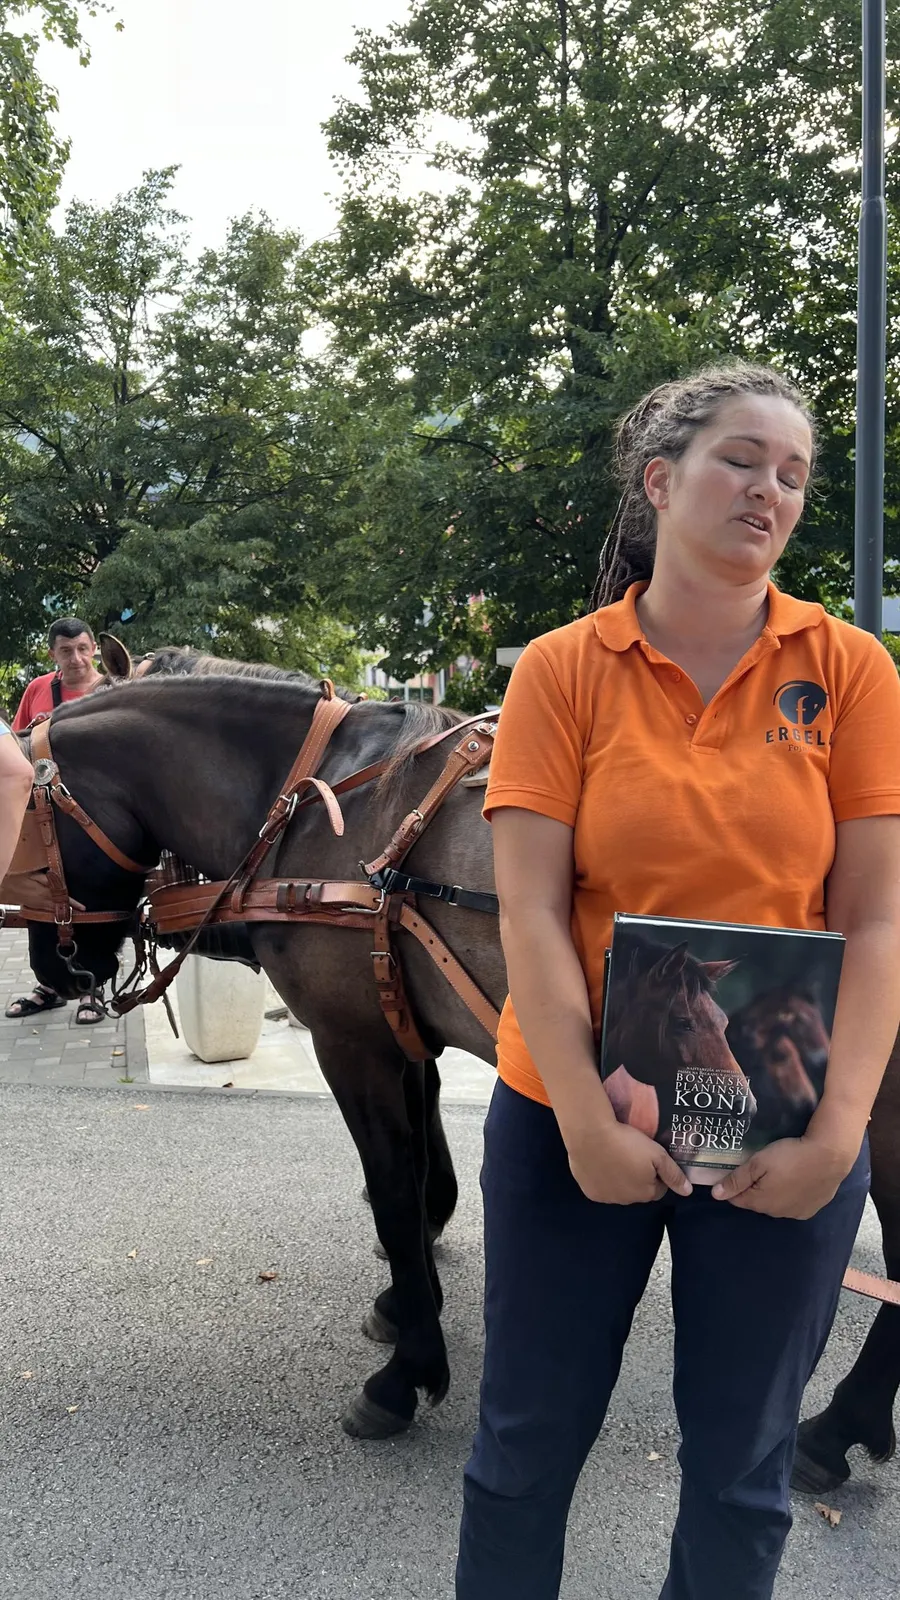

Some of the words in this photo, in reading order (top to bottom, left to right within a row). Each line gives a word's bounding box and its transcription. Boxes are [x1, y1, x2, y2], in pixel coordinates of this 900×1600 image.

[676, 1072, 750, 1087] BOSANSKI
[675, 1081, 750, 1096] PLANINSKI
[674, 1090, 748, 1115] KONJ
[672, 1114, 745, 1128] BOSNIAN
[671, 1123, 745, 1137] MOUNTAIN
[670, 1131, 743, 1151] HORSE
